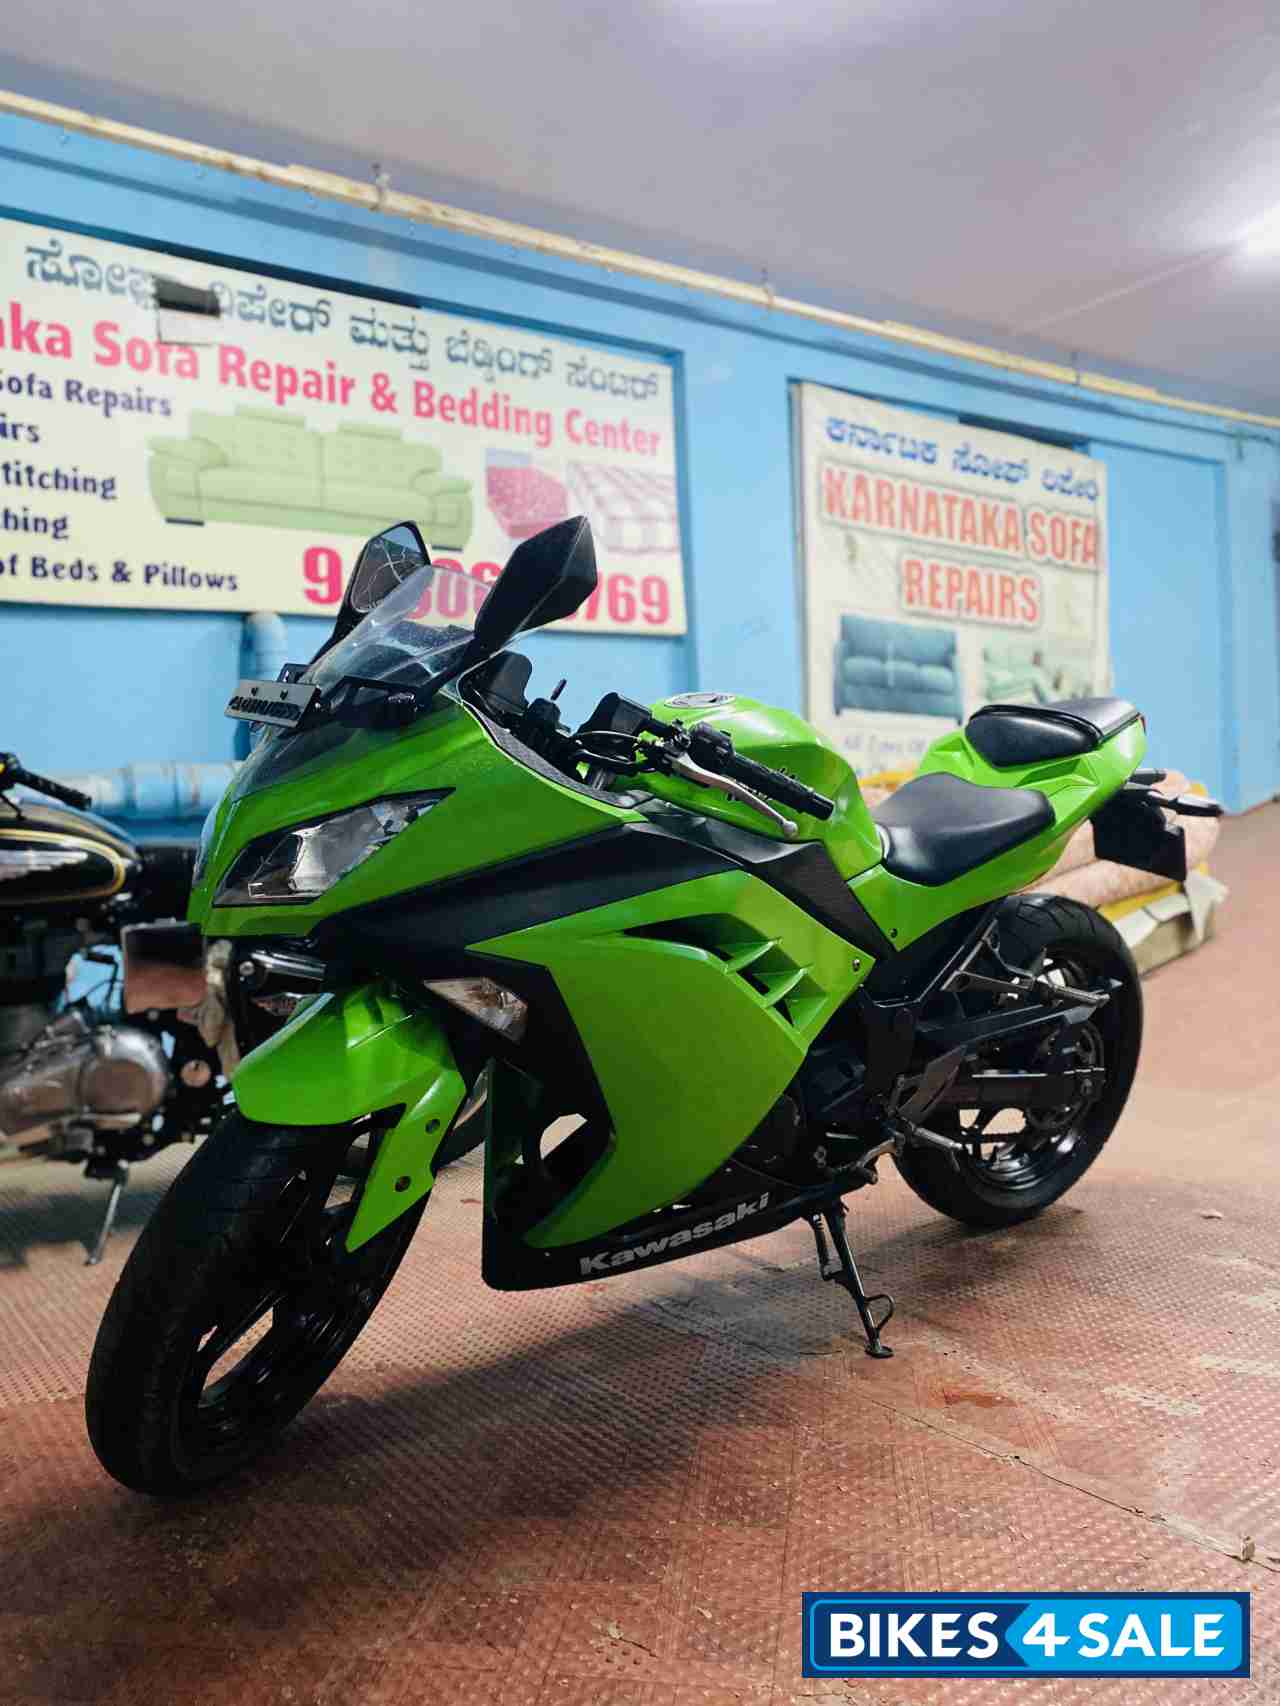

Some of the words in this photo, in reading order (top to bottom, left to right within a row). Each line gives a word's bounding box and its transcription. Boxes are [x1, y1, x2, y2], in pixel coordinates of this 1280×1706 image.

[0, 300, 72, 359] ka
[94, 320, 199, 380] Sofa
[219, 343, 355, 407] Repair
[370, 371, 398, 414] &
[413, 379, 553, 449] Bedding
[564, 408, 662, 457] Center
[0, 369, 52, 399] ofa
[64, 378, 172, 418] Repairs
[823, 468, 1022, 551] KARNATAKA
[1028, 510, 1100, 564] SOFA
[31, 556, 98, 582] Beds
[111, 560, 132, 583] &
[143, 562, 238, 591] Pillows
[903, 559, 1041, 623] REPAIRS
[579, 1191, 770, 1276] Kawasaki
